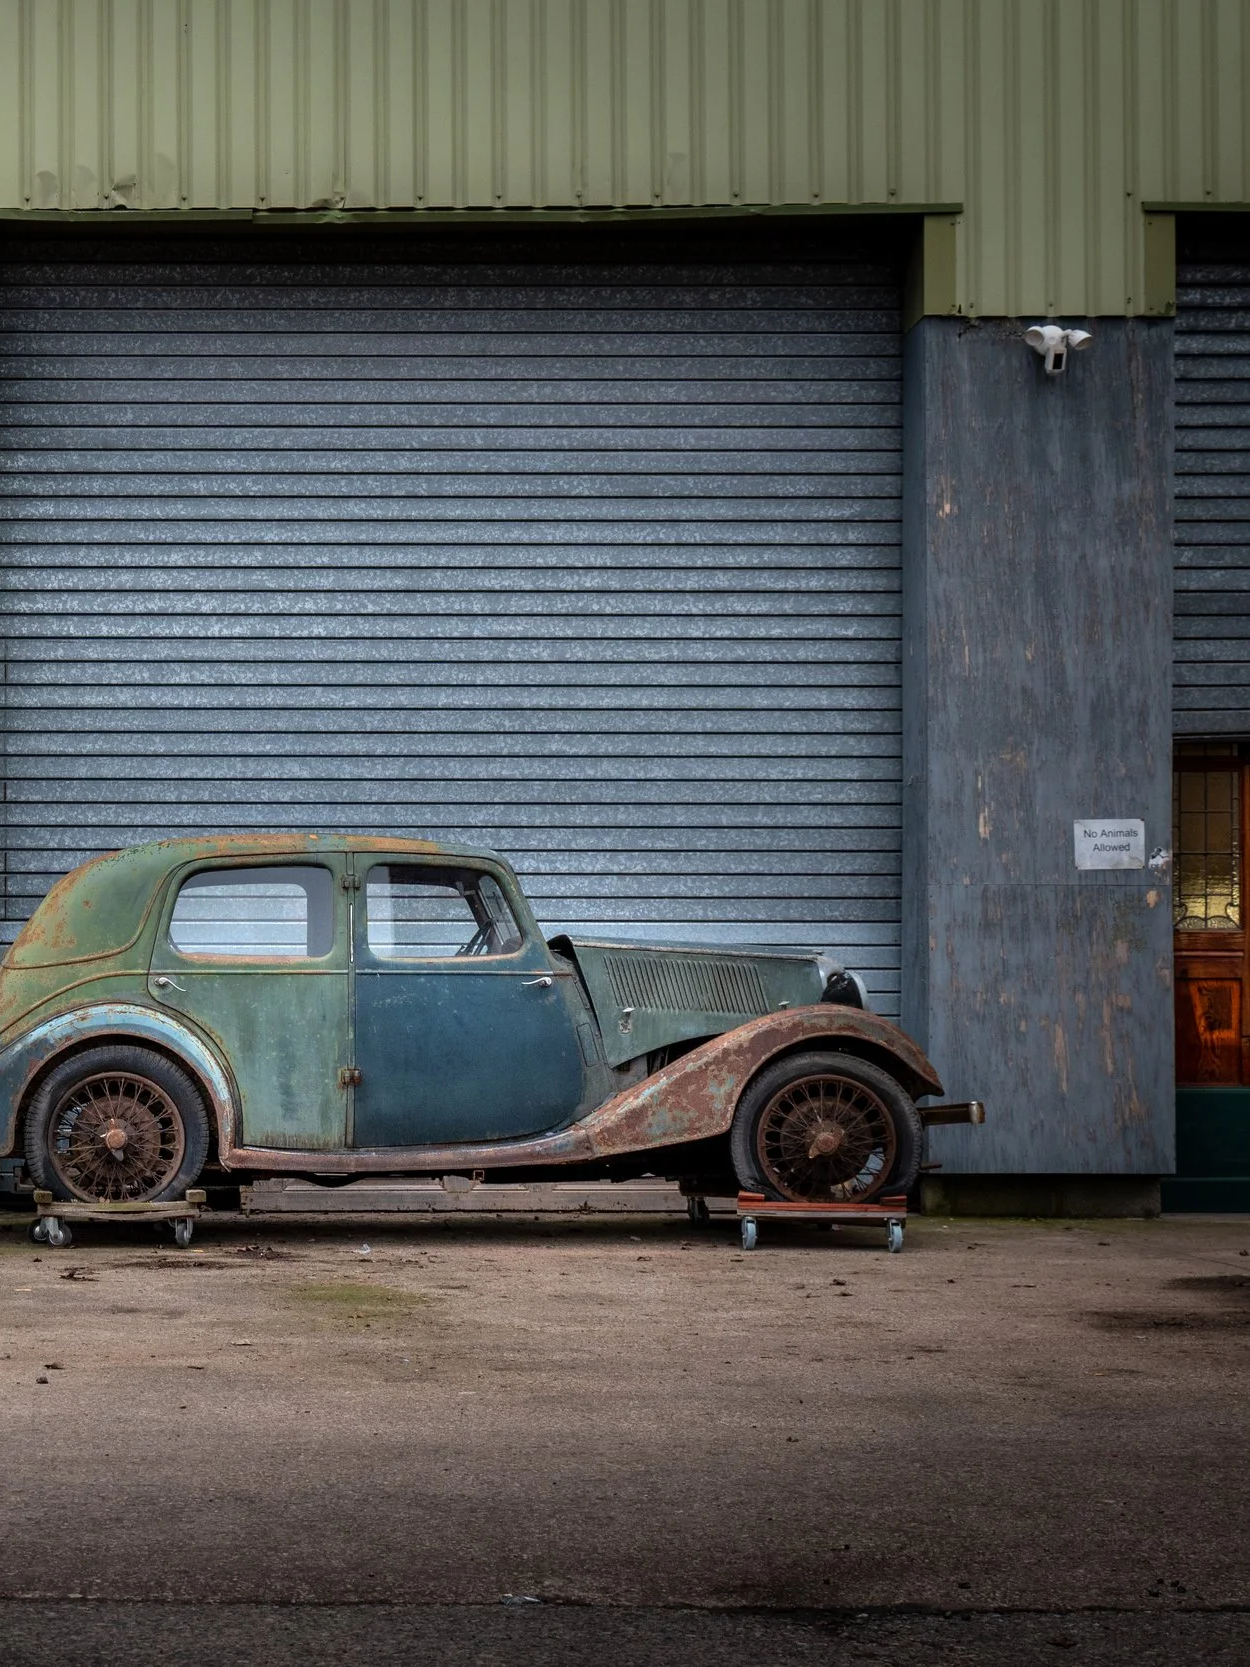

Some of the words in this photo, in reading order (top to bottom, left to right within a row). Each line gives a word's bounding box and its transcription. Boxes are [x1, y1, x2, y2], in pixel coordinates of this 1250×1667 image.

[1083, 830, 1098, 838] No
[1100, 829, 1139, 838] Animals
[1092, 843, 1131, 852] Allowed
